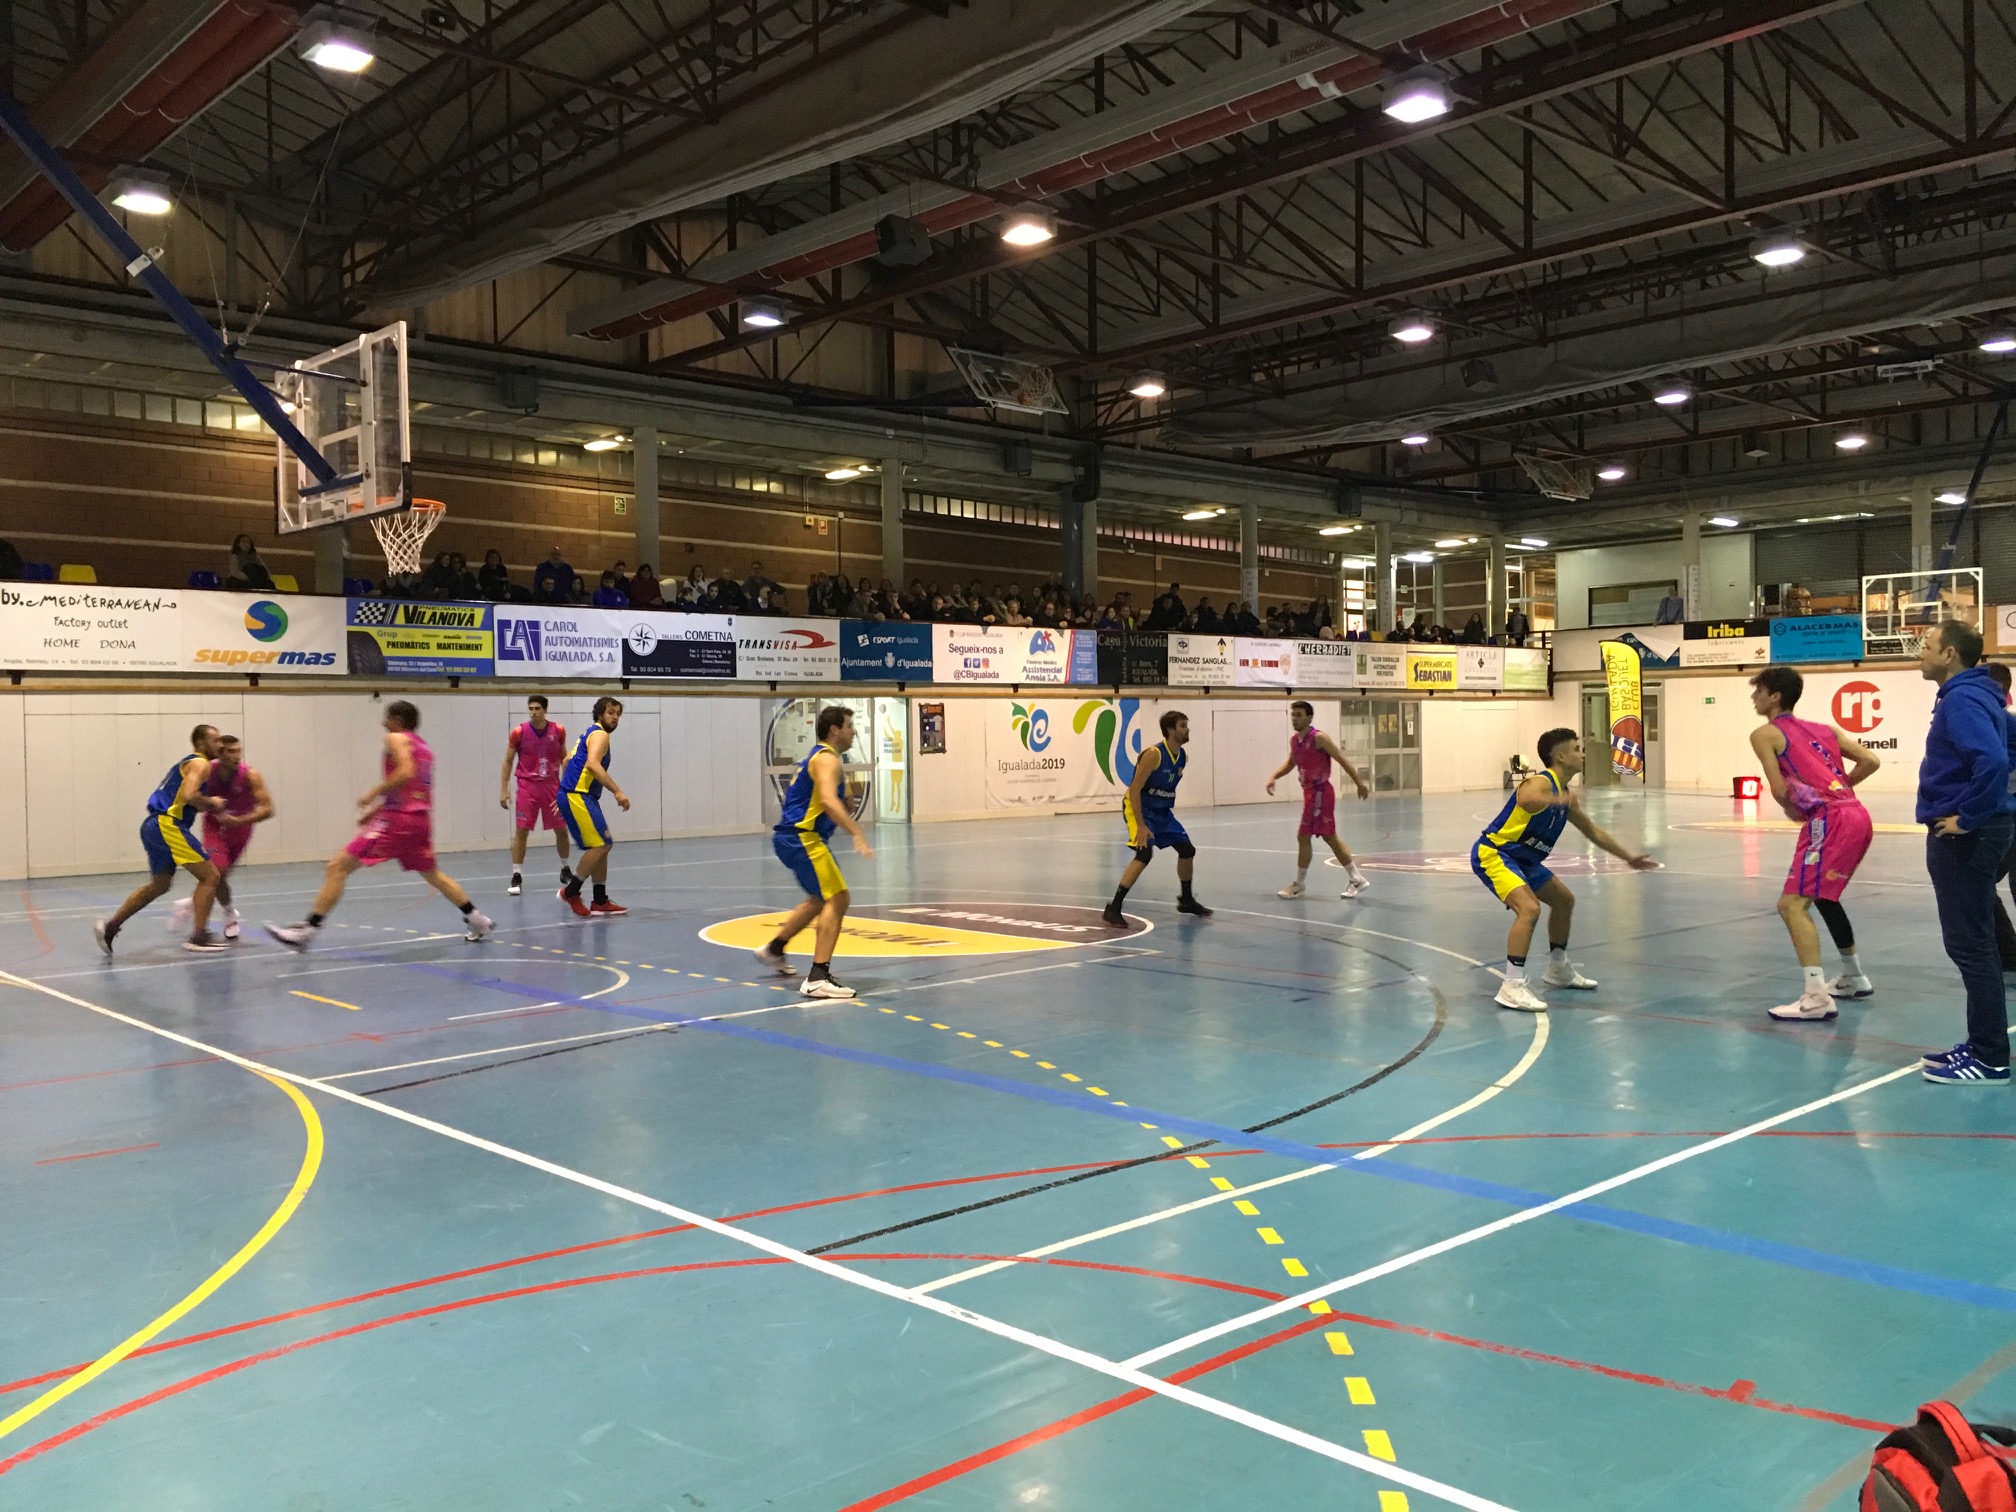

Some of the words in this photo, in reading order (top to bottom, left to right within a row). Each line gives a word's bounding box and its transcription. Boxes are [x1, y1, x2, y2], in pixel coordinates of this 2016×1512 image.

[544, 621, 578, 632] CAROL
[1707, 623, 1745, 638] Iriba
[377, 630, 398, 639] Grup
[685, 630, 733, 641] COMETNA
[43, 638, 81, 648] HOME
[100, 639, 137, 649] DONA
[436, 642, 483, 651] MANTENIMENT
[544, 635, 619, 648] AUTOMATISMES
[738, 639, 798, 650] TRANSVISA
[948, 643, 997, 655] Segueix-nos
[998, 646, 1004, 654] a
[193, 649, 337, 666] supermas
[1169, 656, 1201, 665] FERNANDEZ
[841, 658, 882, 668] Ajuntament
[897, 659, 932, 669] d'Igualada
[953, 669, 1000, 680] @CBIgualada
[1022, 665, 1063, 674] Assistencial
[998, 757, 1066, 774] Igualada2019
